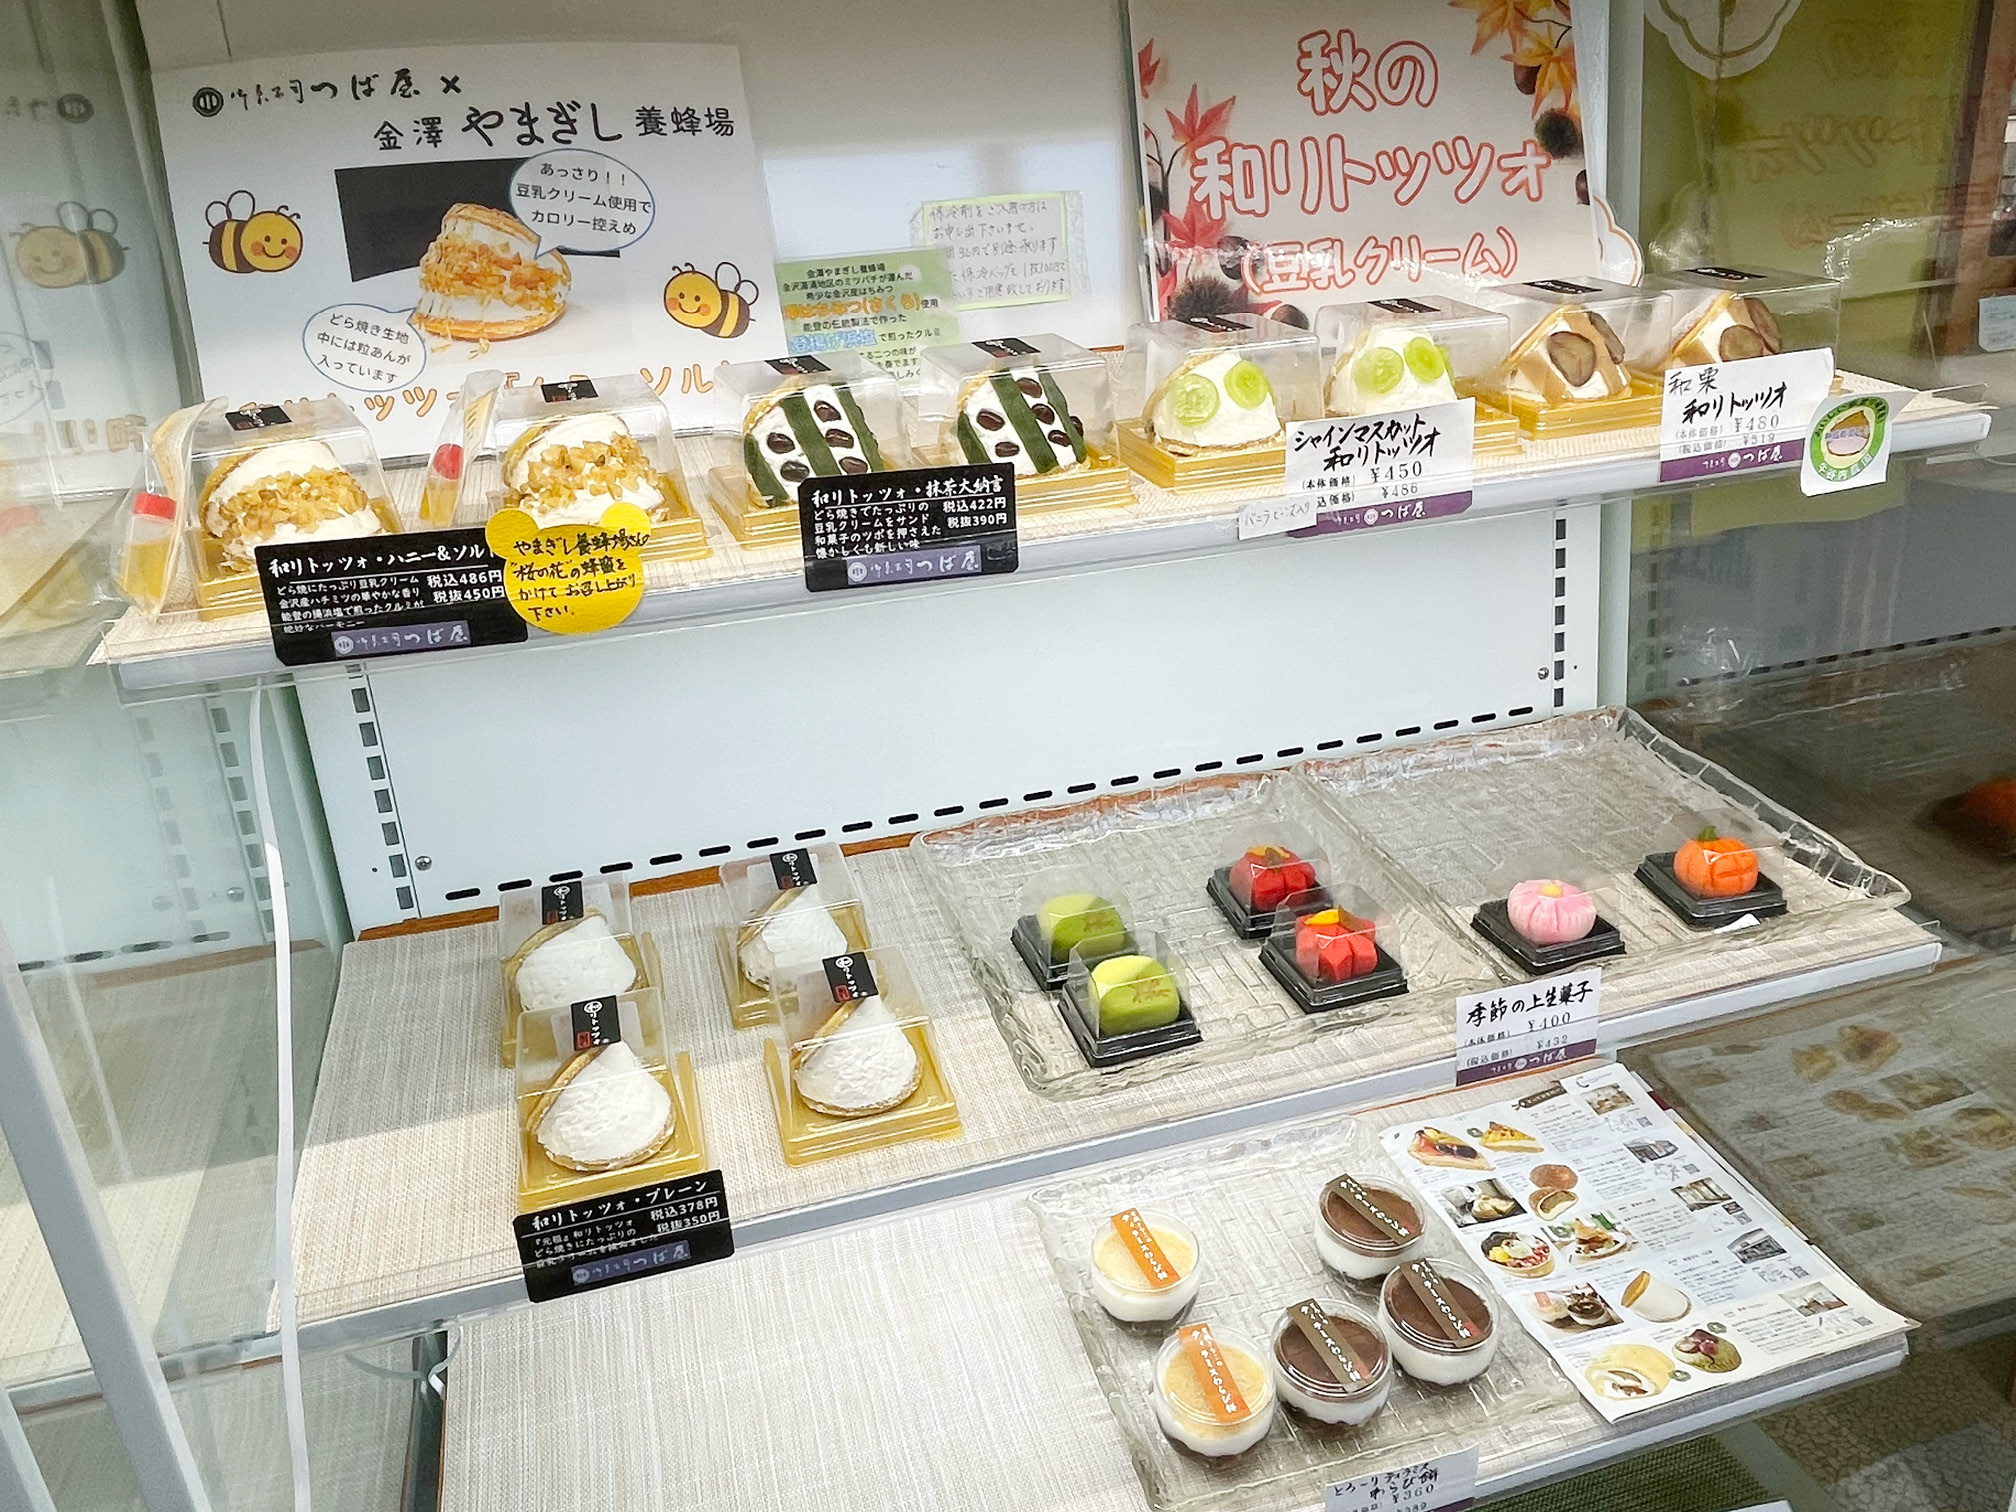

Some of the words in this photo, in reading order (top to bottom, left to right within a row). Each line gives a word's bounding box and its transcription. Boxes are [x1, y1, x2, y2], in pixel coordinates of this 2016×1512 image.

[1297, 28, 1439, 116] 秋の
[1191, 133, 1553, 222] 和リトッツォ
[515, 183, 652, 214] 豆乳クリーム使用で
[532, 209, 637, 235] カロリー控えめ
[329, 312, 410, 345] どら焼き生地
[316, 331, 412, 365] 中には粒あんが
[316, 354, 399, 384] 入っています
[1668, 366, 1719, 395] 和栗
[1294, 413, 1426, 452] シャインマスカット
[1734, 414, 1780, 433] ¥480
[1370, 460, 1423, 484] ¥450
[811, 475, 1004, 508] 和リトッツォ・抹茶大納言
[1381, 481, 1419, 499] ¥486
[813, 501, 929, 521] どら焼きでたっぷりの
[942, 496, 1007, 514] 税込422円
[813, 513, 930, 535] 豆乳クリームをサンド
[947, 512, 1008, 529] 税抜390円
[814, 525, 942, 546] 和菓子のツボを押さえた
[513, 528, 650, 557] やまぎし養蜂場さんの
[427, 569, 503, 588] 税込486円
[278, 587, 420, 609] 金沢産ハチミツの華やかな香り
[433, 585, 505, 604] 税抜450円
[1466, 980, 1593, 1028] 季節の上生菓子
[1528, 1012, 1571, 1033] ¥400
[1537, 1034, 1568, 1050] ¥432
[531, 1179, 707, 1231] 和リトッツォ・プレーン
[650, 1196, 719, 1221] 税込378円
[534, 1227, 637, 1258] どら焼きにたっぷりの
[656, 1210, 721, 1234] 税抜350円
